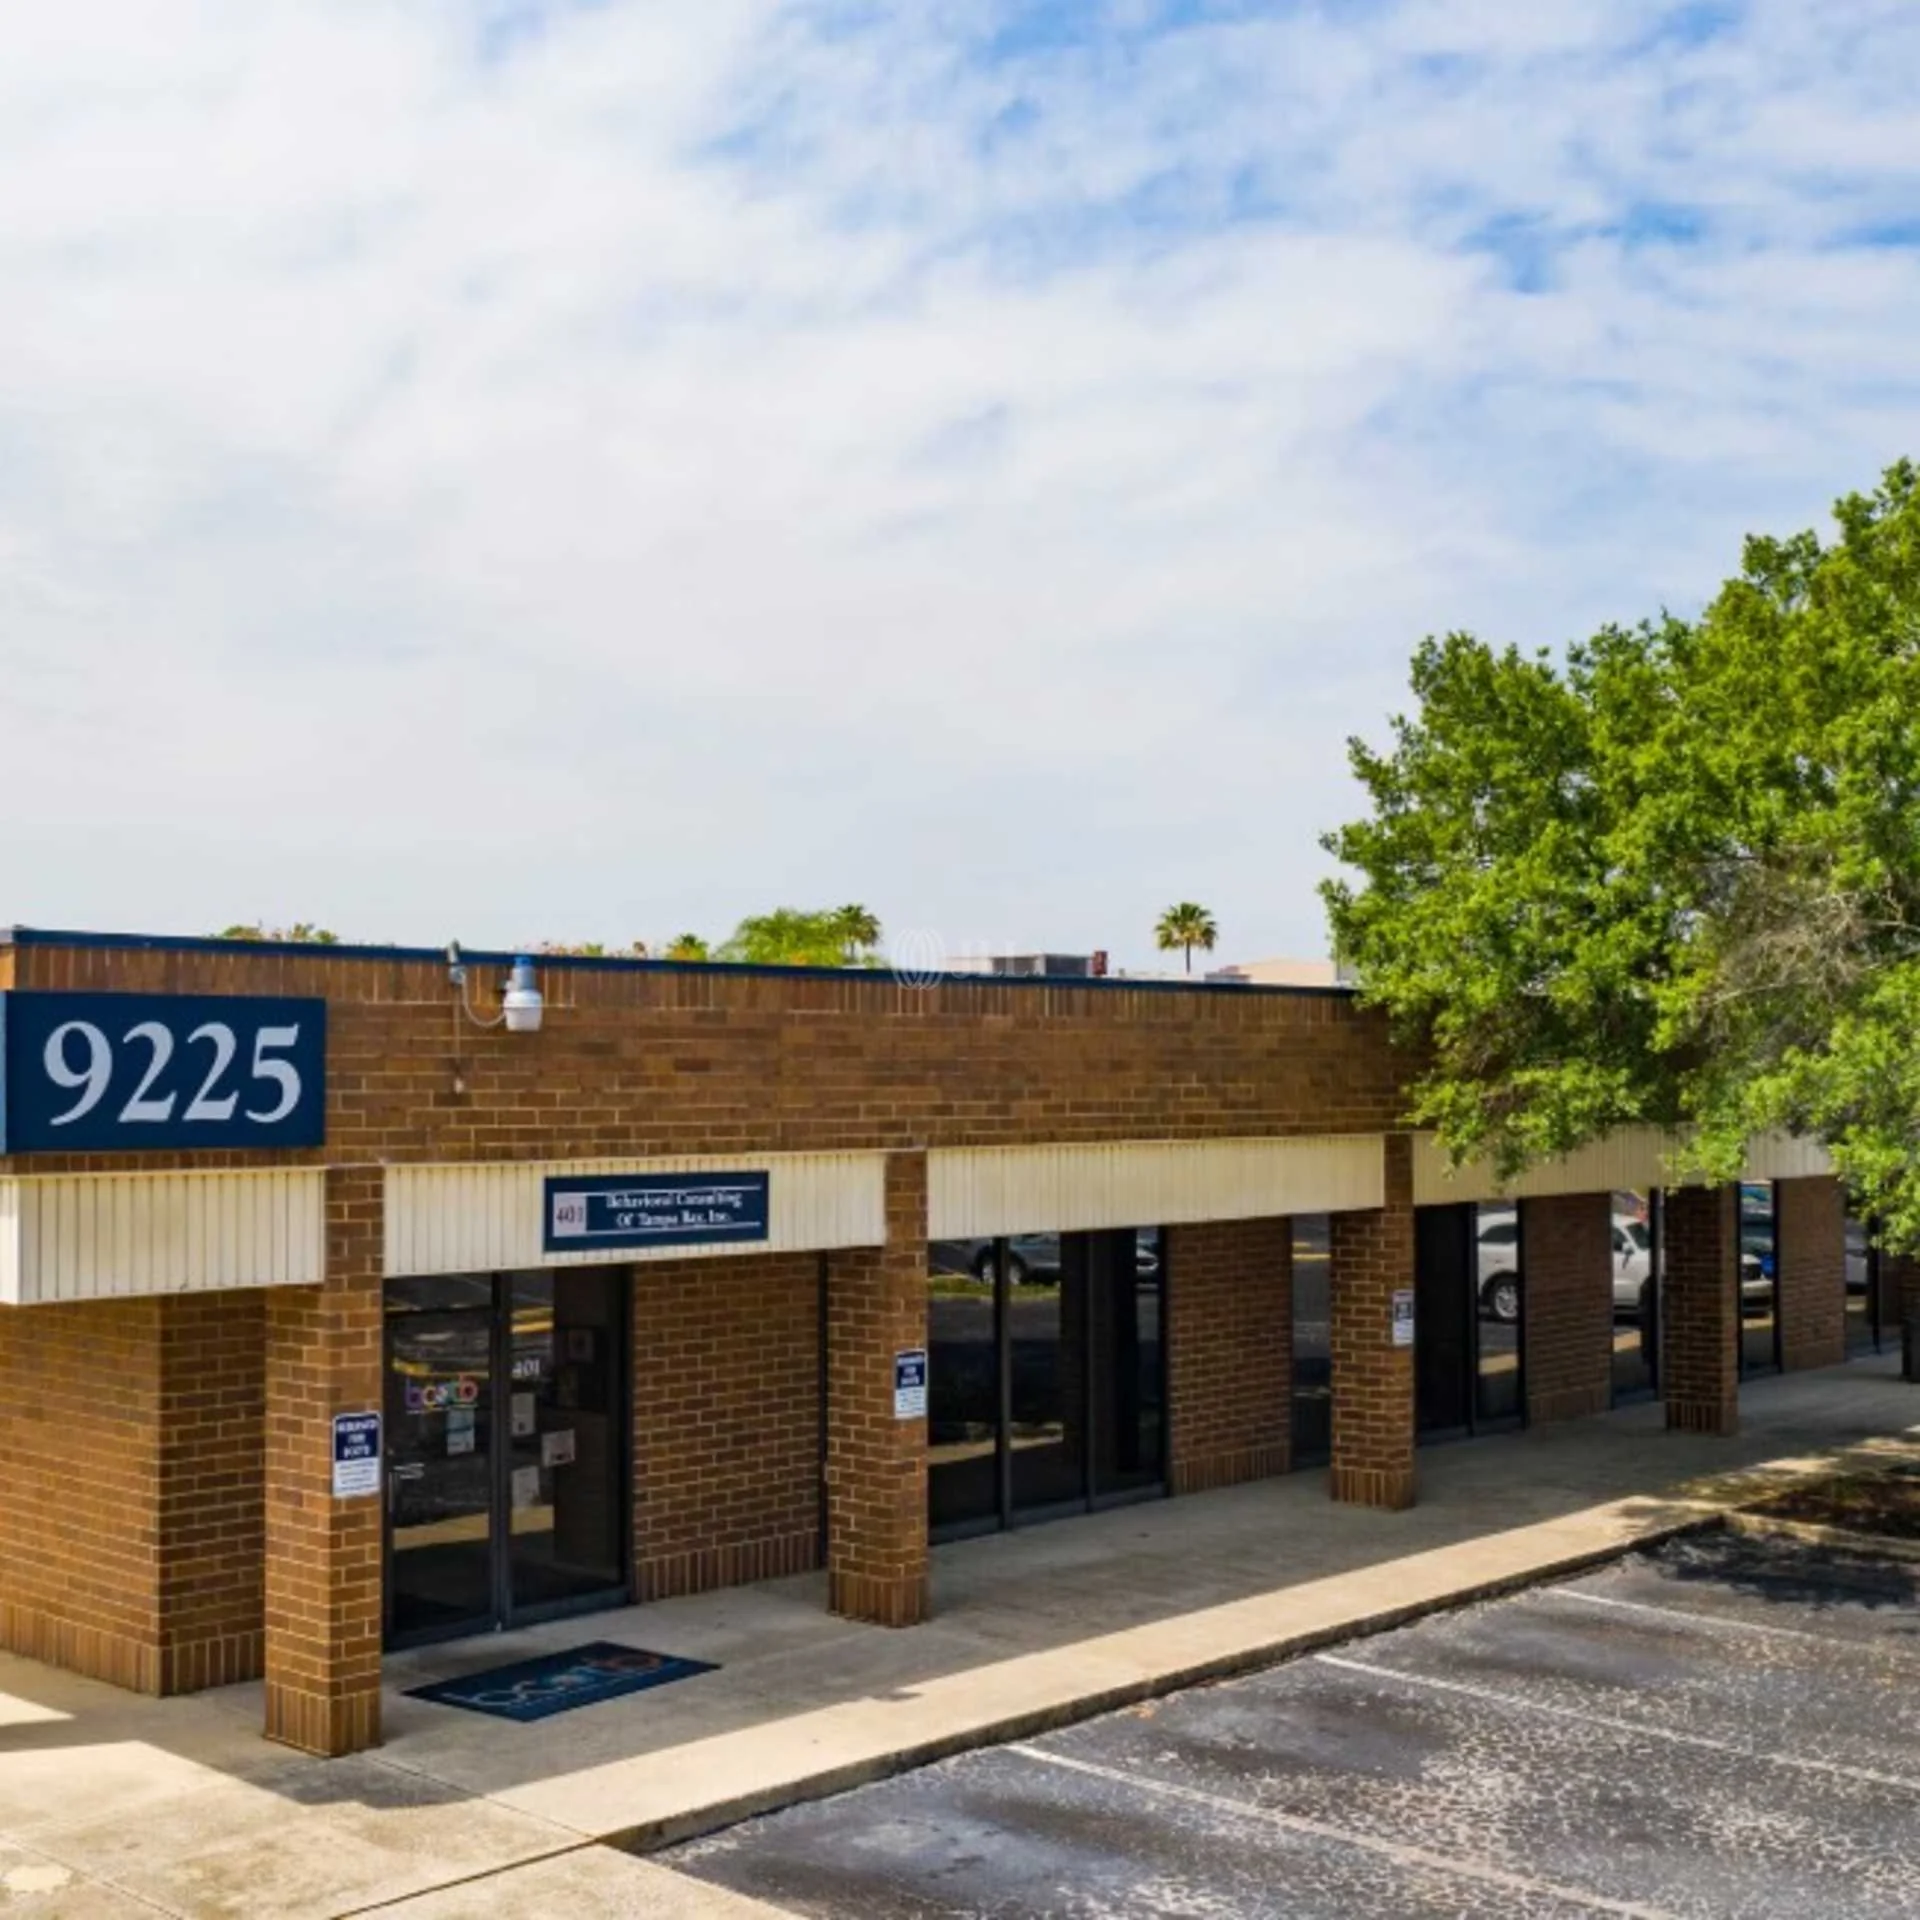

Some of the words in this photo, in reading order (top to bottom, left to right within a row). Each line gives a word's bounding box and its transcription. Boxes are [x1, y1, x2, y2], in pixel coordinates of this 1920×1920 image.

[43, 1020, 302, 1127] 9225
[556, 1206, 584, 1223] 401
[512, 1358, 541, 1377] 401
